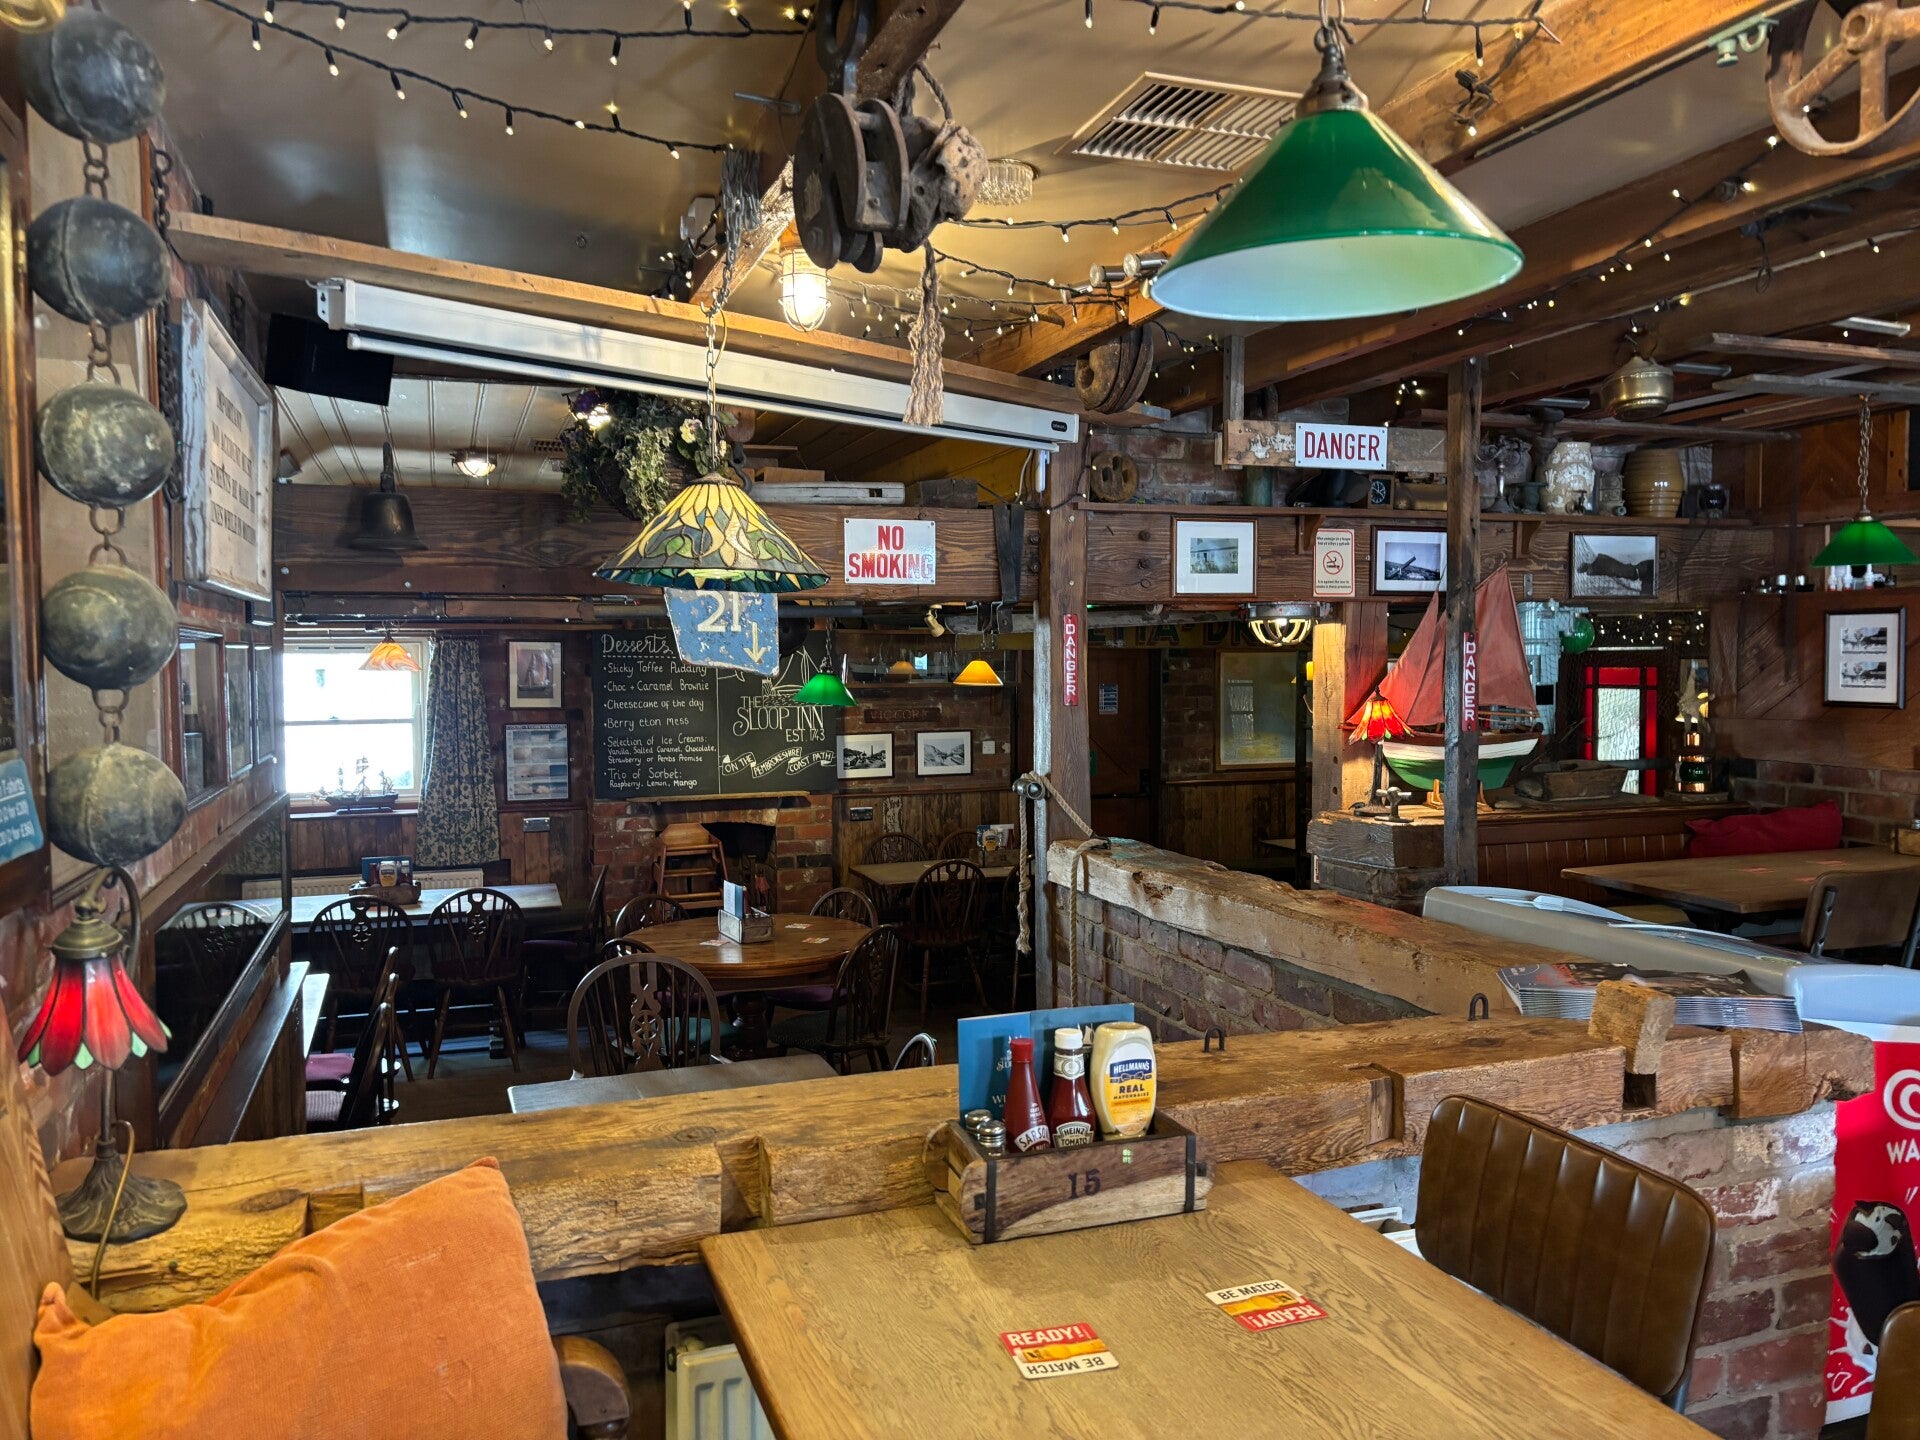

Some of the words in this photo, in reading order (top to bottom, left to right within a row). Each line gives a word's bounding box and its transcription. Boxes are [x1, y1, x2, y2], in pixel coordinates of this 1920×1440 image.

[1304, 431, 1380, 461] DANGER
[877, 525, 904, 550] NO
[848, 552, 934, 579] SMOKING
[601, 633, 673, 654] Desserts
[1065, 624, 1076, 695] DANGER
[607, 662, 633, 678] Sticky
[637, 661, 663, 673] Toffee
[670, 661, 707, 677] Pudding
[607, 681, 626, 692] Choc
[637, 680, 673, 692] Caramel
[680, 679, 709, 691] Brownie
[1464, 641, 1476, 721] DANGER
[607, 699, 658, 710] Cheesecake
[661, 700, 669, 710] of
[672, 698, 686, 707] the
[688, 697, 704, 711] day
[740, 695, 761, 708] THE
[607, 718, 634, 731] Berry
[639, 718, 661, 727] eton
[733, 706, 790, 737] SLOOP
[797, 706, 824, 730] INN
[607, 736, 642, 747] Selection
[646, 735, 654, 745] of
[661, 736, 673, 744] Ice
[633, 745, 653, 754] Salted
[608, 755, 642, 766] Strawberry
[678, 753, 703, 762] Promise
[724, 762, 739, 773] ON
[738, 753, 754, 767] THE
[753, 748, 801, 777] PEMBROKESHIRE
[788, 755, 810, 773] COAST
[812, 751, 832, 762] PATH
[607, 768, 627, 780] Trio
[632, 768, 640, 779] of
[673, 779, 698, 789] Mango
[1113, 1061, 1150, 1074] HELLMANN'S
[1119, 1084, 1145, 1094] REAL
[1063, 1126, 1085, 1136] HEINZ
[1061, 1137, 1088, 1146] TOMATO
[1886, 1138, 1920, 1165] WA
[1068, 1168, 1101, 1200] 15
[1217, 1289, 1239, 1300] BE
[1237, 1281, 1285, 1296] MATCH
[1247, 1304, 1321, 1327] READY!
[1006, 1325, 1084, 1347] READY!
[1026, 1360, 1080, 1375] MATCH
[1082, 1356, 1105, 1368] BE
